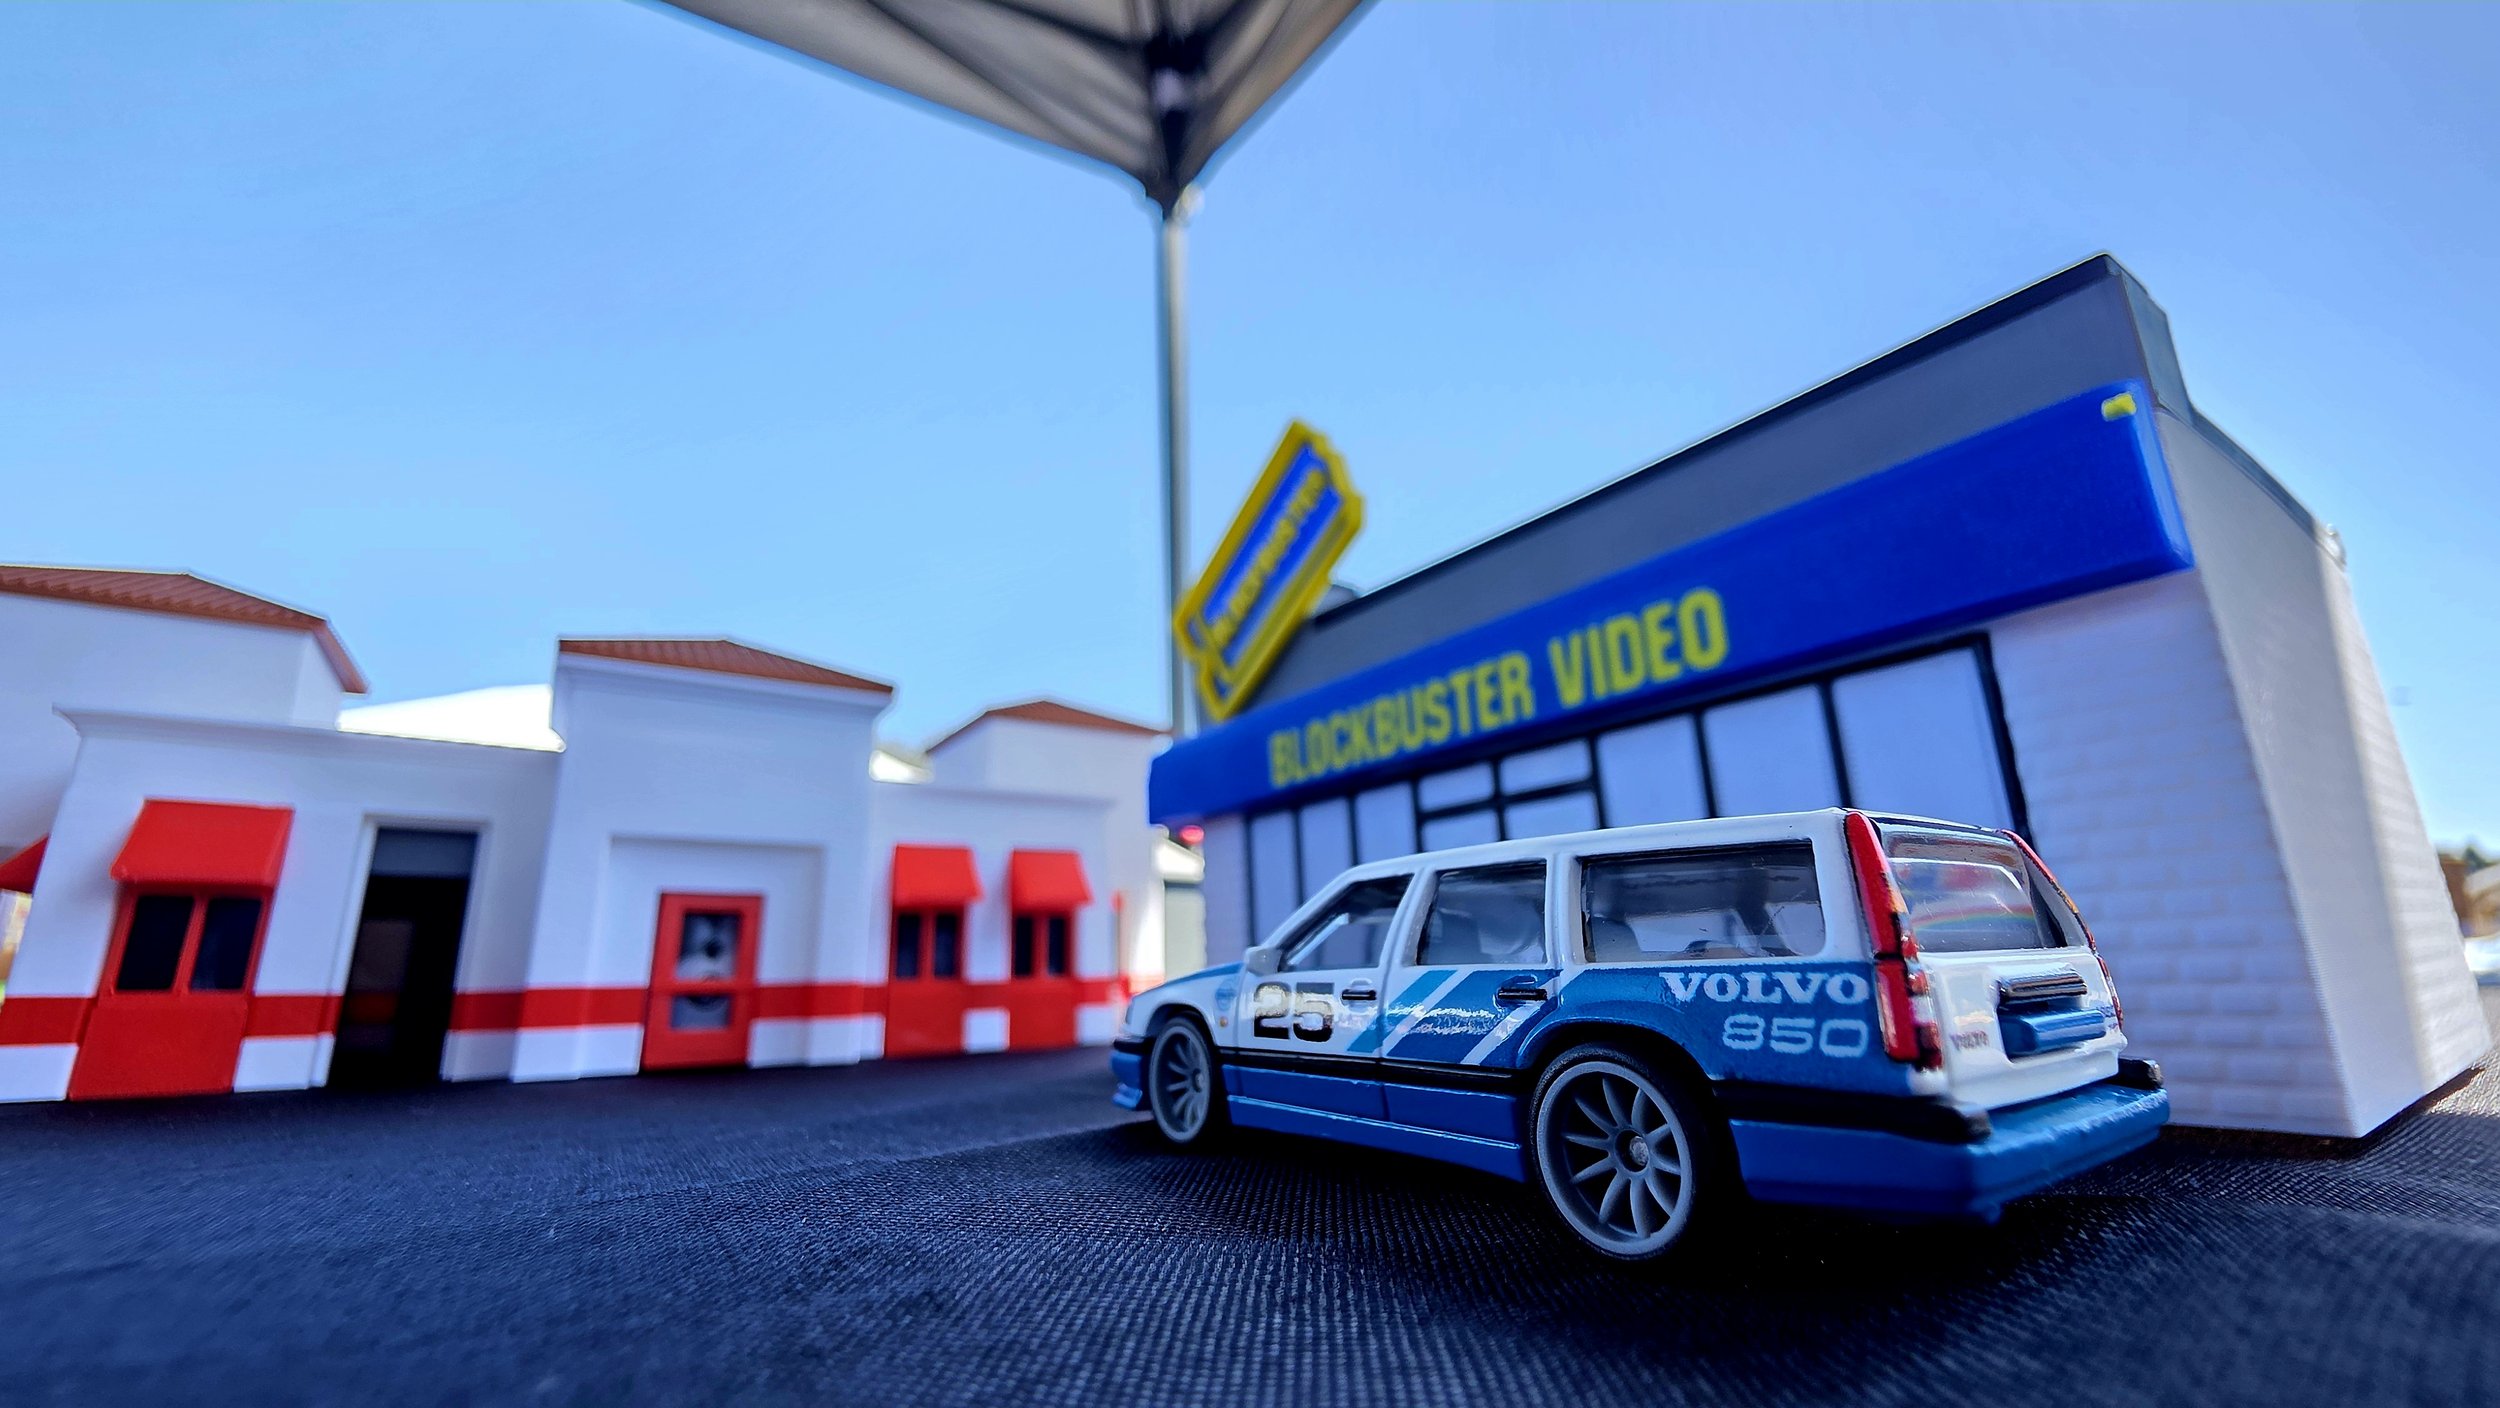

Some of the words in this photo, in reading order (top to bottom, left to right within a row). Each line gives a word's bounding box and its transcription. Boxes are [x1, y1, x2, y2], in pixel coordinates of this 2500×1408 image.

[1268, 652, 1534, 788] BLOCKBUSTER
[1548, 588, 1729, 707] VIDEO
[1254, 983, 1334, 1041] 25
[1658, 971, 1870, 1004] VOLVO
[1722, 1013, 1869, 1058] 850
